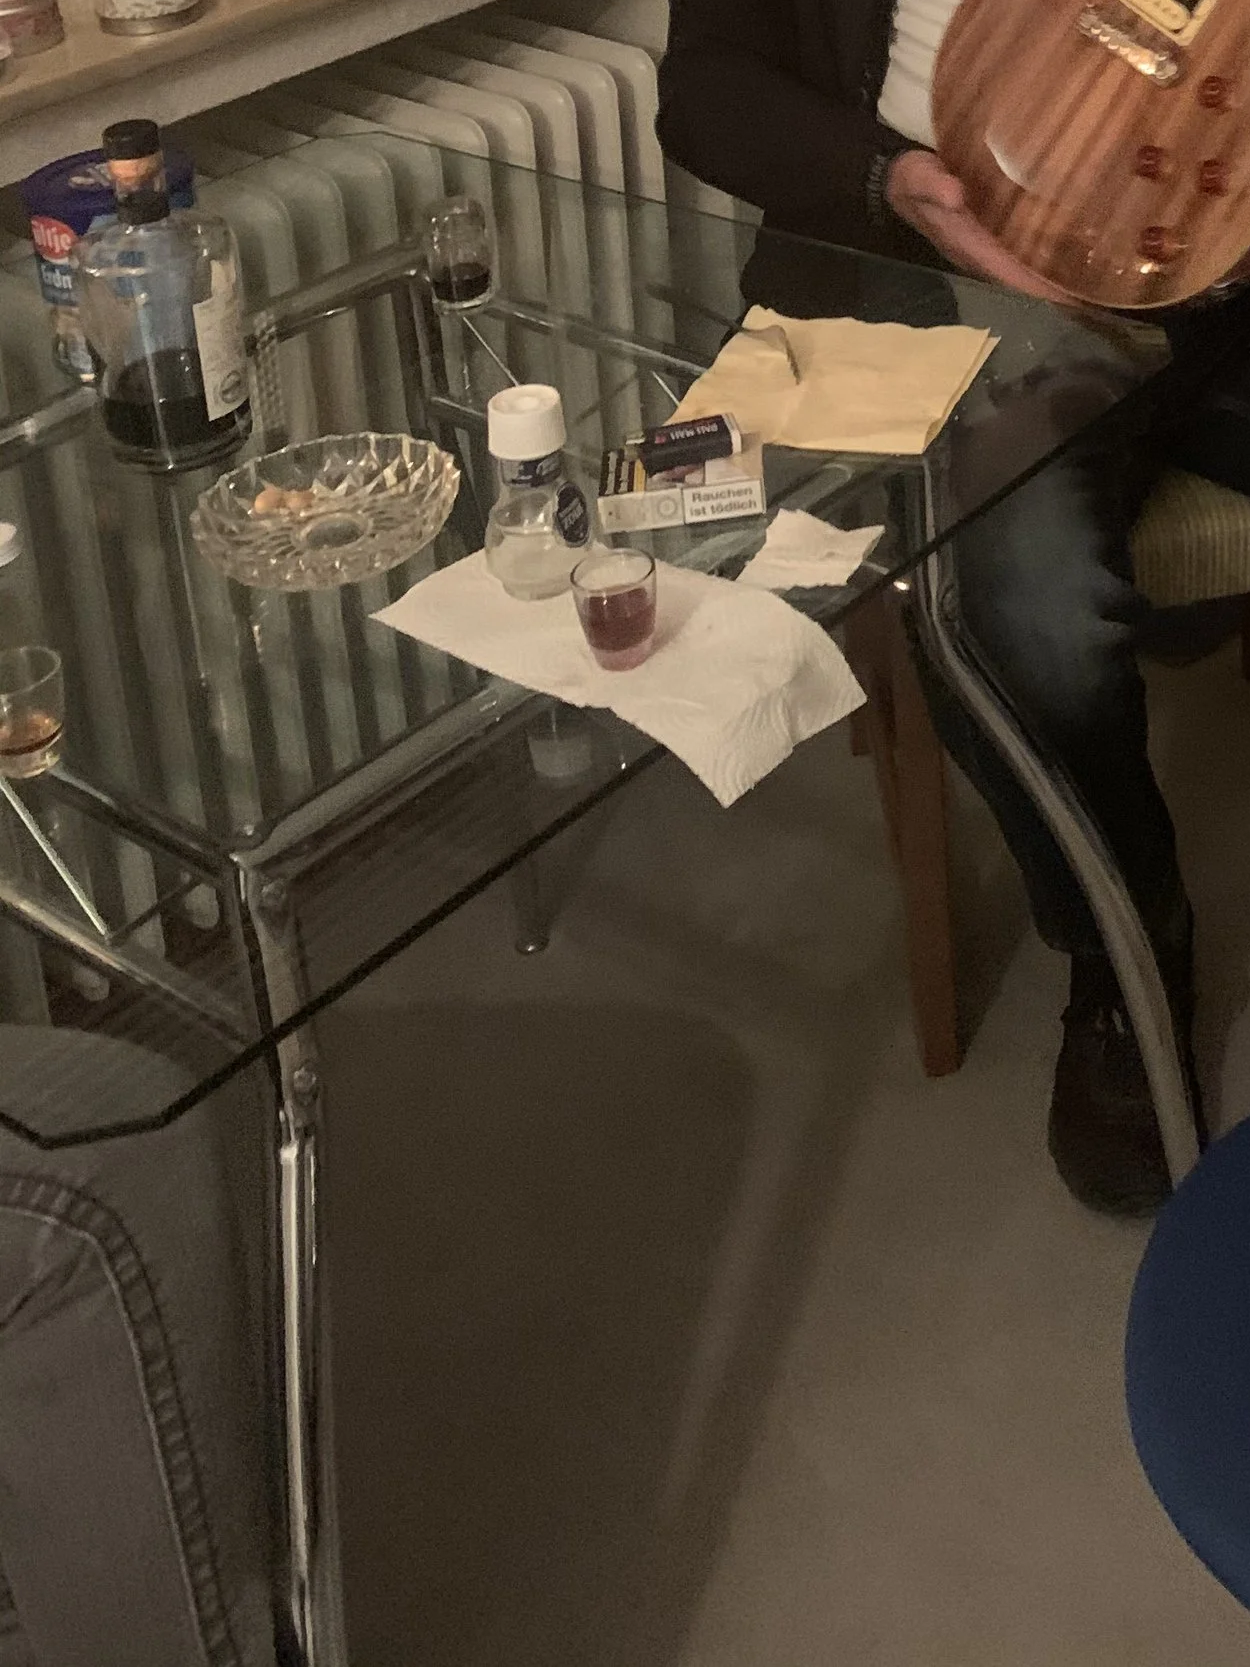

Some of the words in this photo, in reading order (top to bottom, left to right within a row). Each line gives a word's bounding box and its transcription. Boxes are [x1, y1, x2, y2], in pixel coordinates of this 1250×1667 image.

[692, 486, 753, 503] Rauchen
[690, 506, 707, 517] ist
[710, 498, 757, 516] tödlich
